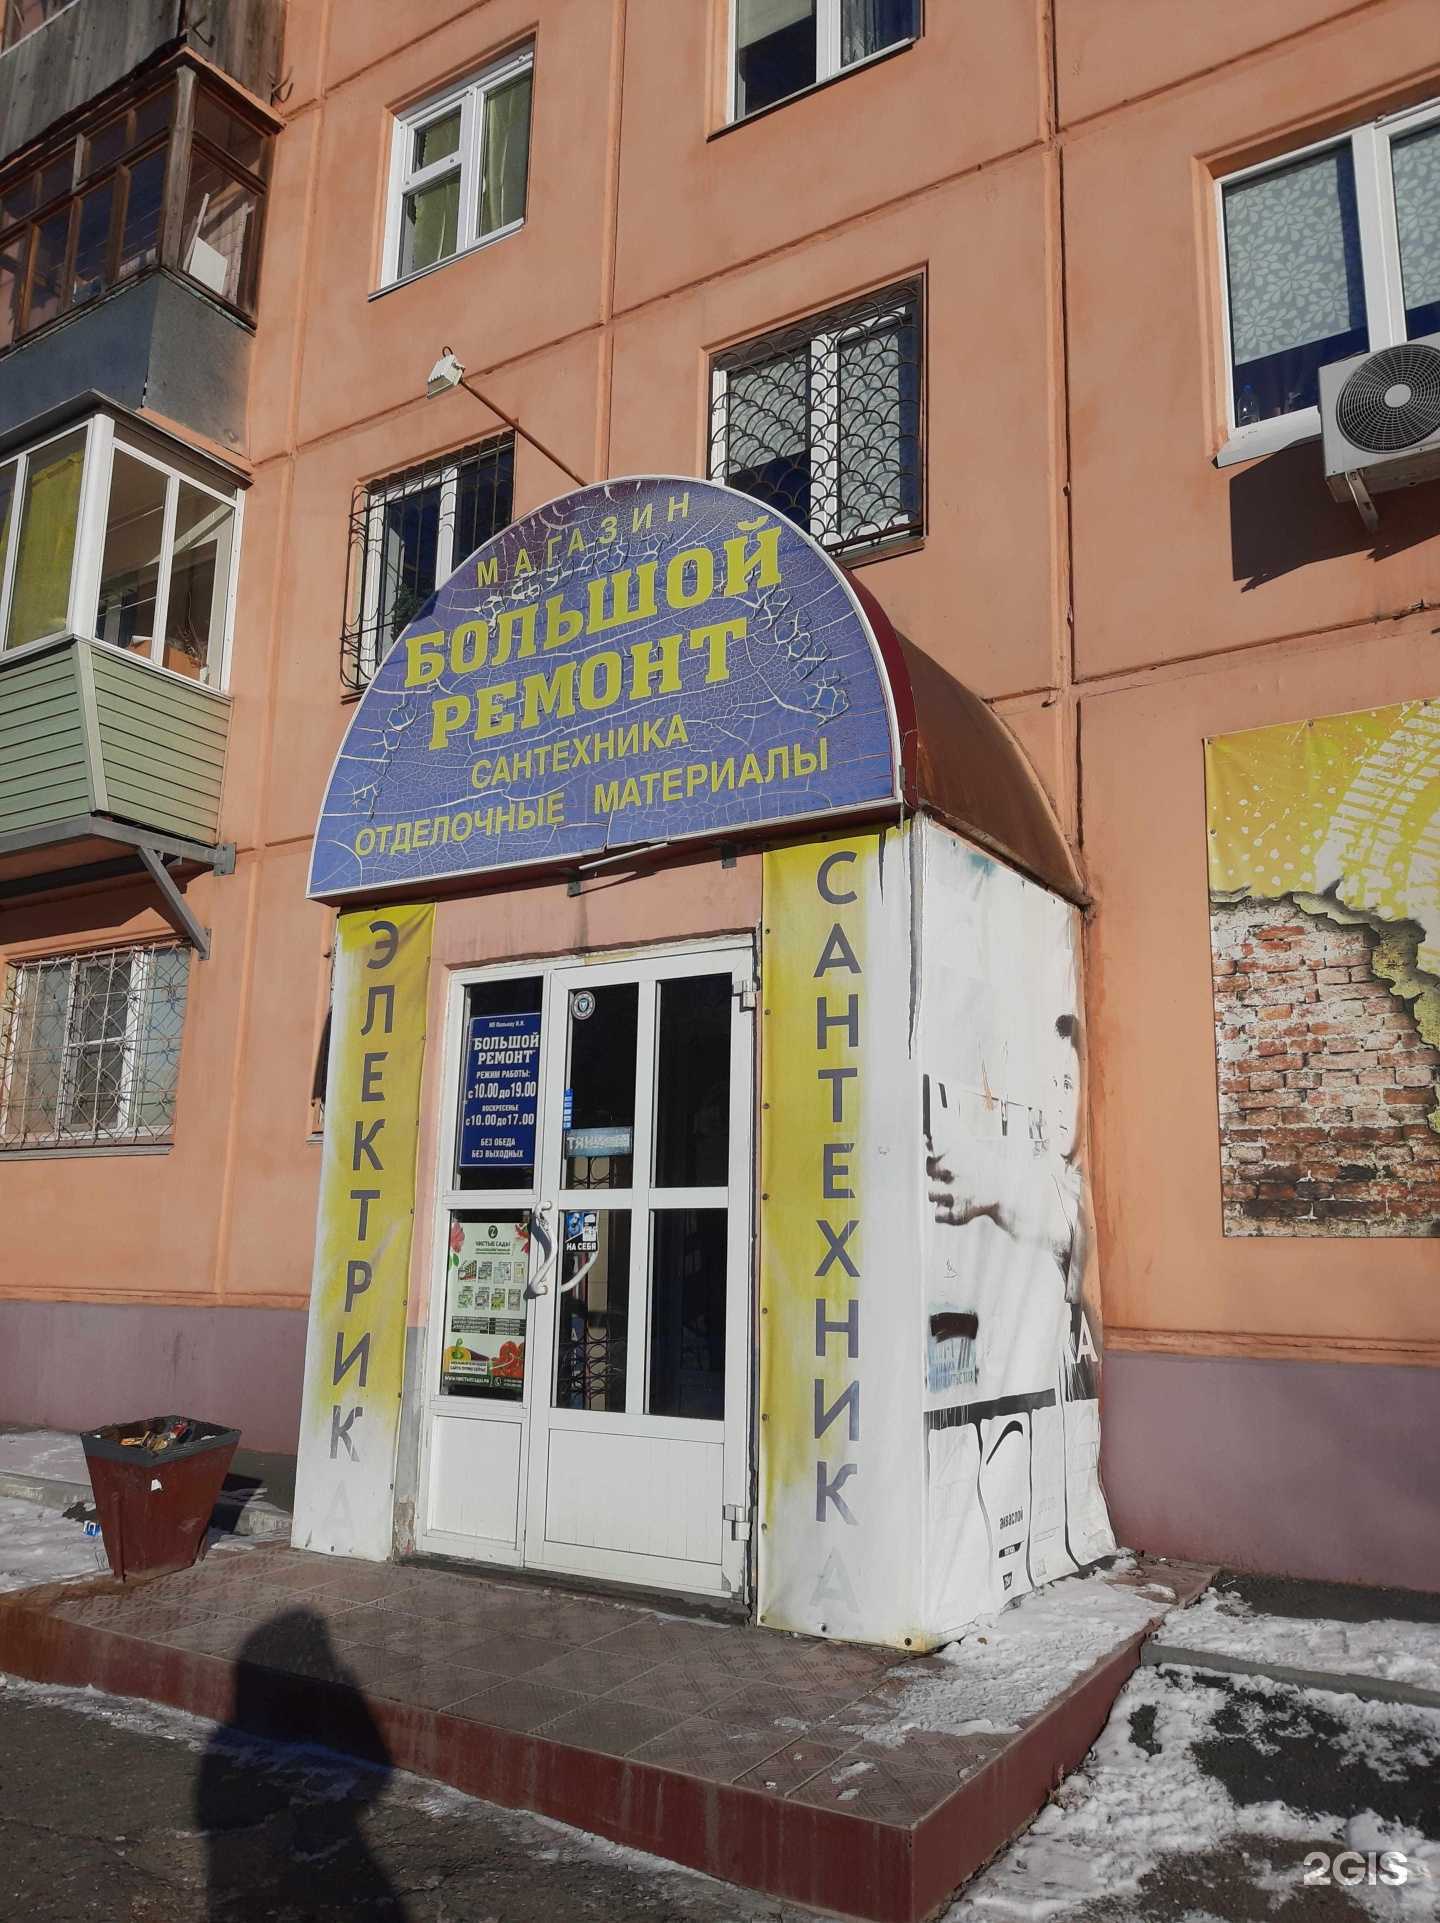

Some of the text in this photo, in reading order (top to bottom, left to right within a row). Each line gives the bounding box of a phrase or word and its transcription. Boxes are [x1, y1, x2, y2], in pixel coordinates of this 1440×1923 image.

[477, 492, 690, 587] МАГАЗИН
[404, 516, 783, 688] БОЛЬШОЙ
[429, 617, 748, 750] РЕМОНТ
[471, 714, 688, 790] САНТЕХНИКА
[356, 738, 828, 857] ОТДЕЛОЧНЫЕ МАТЕРИАЛЫ
[473, 1032, 540, 1050] БОЛЬШОЙ
[478, 1050, 535, 1065] РЕМОНТ
[477, 1071, 500, 1079] РЕЖИМ
[474, 1082, 499, 1099] 10.00
[499, 1089, 510, 1099] до
[510, 1081, 537, 1098] 19.00
[482, 1104, 520, 1112] ВОСКРЕСЕНЬЕ
[471, 1114, 497, 1126] 10.00
[507, 1113, 535, 1125] 17.00
[480, 1137, 516, 1147] БЕЗ ОБЕДА
[471, 1149, 524, 1158] БЕЗ ВЫХОДНЫХ
[566, 1242, 597, 1251] НА СЕБЯ
